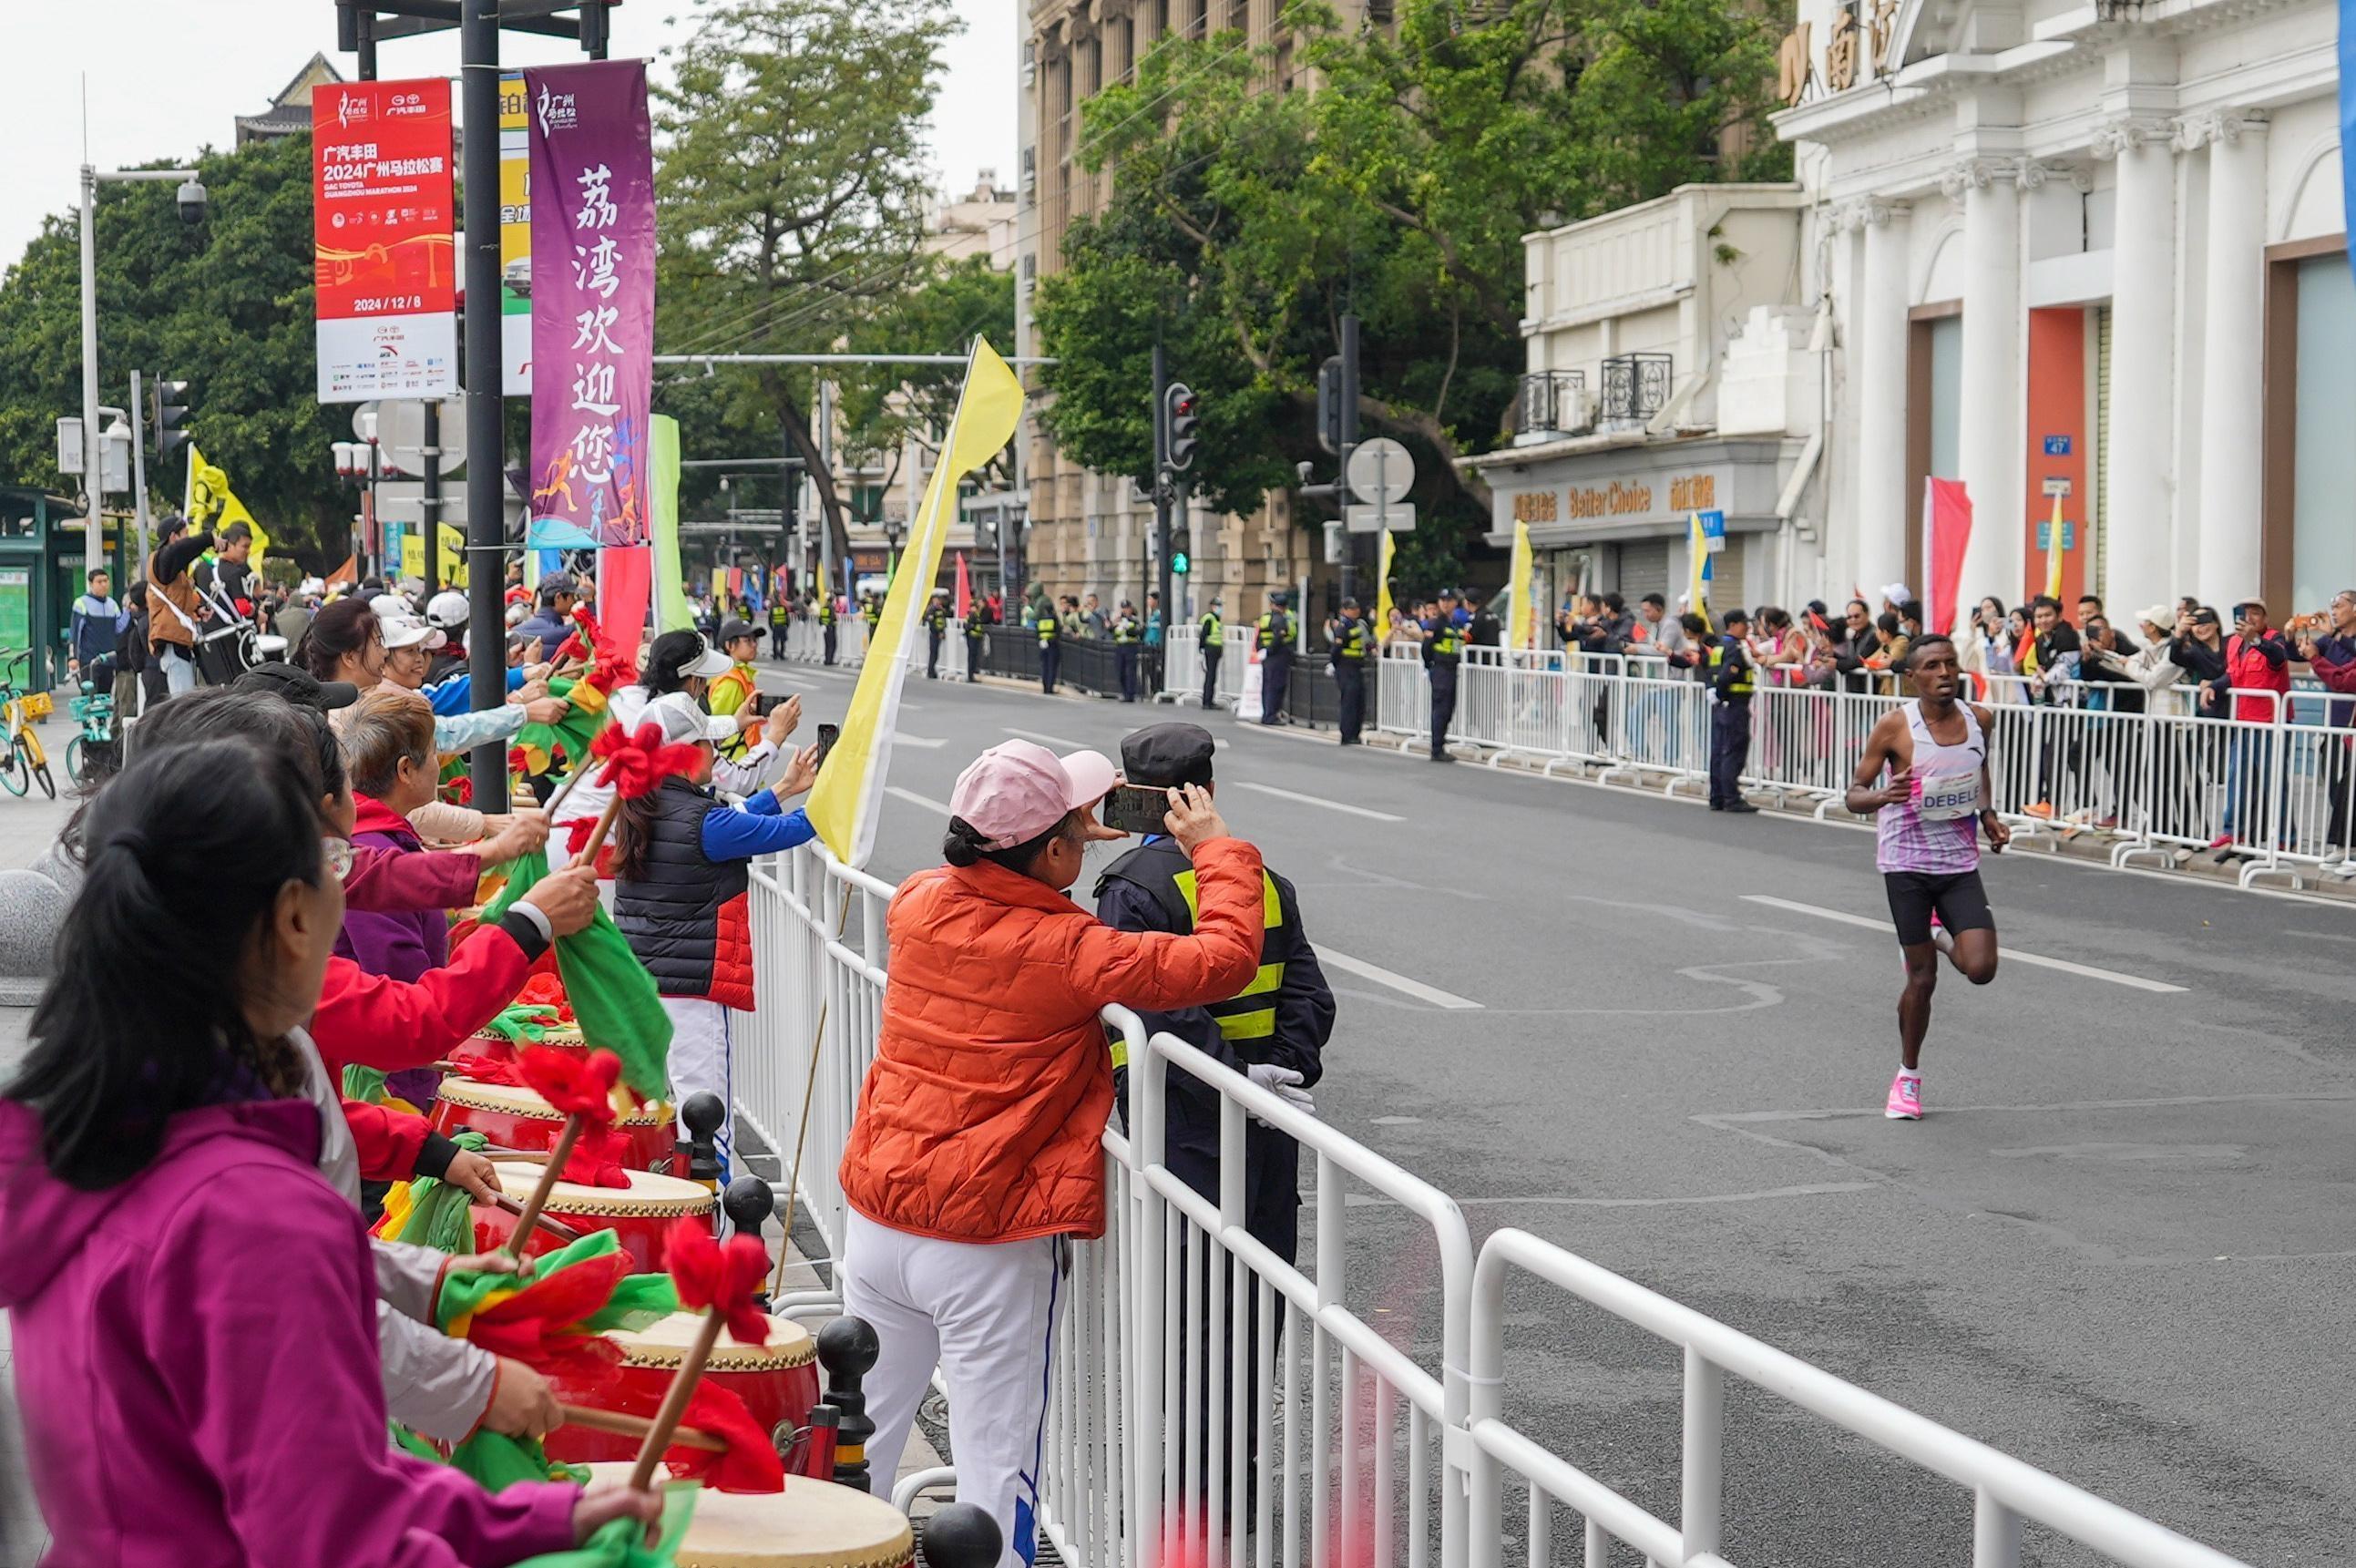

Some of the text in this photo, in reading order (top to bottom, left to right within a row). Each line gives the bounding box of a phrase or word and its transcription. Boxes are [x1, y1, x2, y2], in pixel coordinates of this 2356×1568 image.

[552, 93, 575, 108] 广州
[385, 105, 426, 117] 广汽丰田
[323, 143, 377, 162] 广汽丰田
[323, 157, 443, 181] 2024广州马拉松赛
[323, 184, 418, 200] GUANGZHOU MARATHON 2024
[339, 181, 364, 190] TOYOTA
[354, 299, 381, 312] 2024
[570, 163, 624, 483] 荔湾欢迎您
[2050, 443, 2064, 454] 47
[1569, 486, 1607, 519] Better
[1608, 479, 1653, 514] Choice
